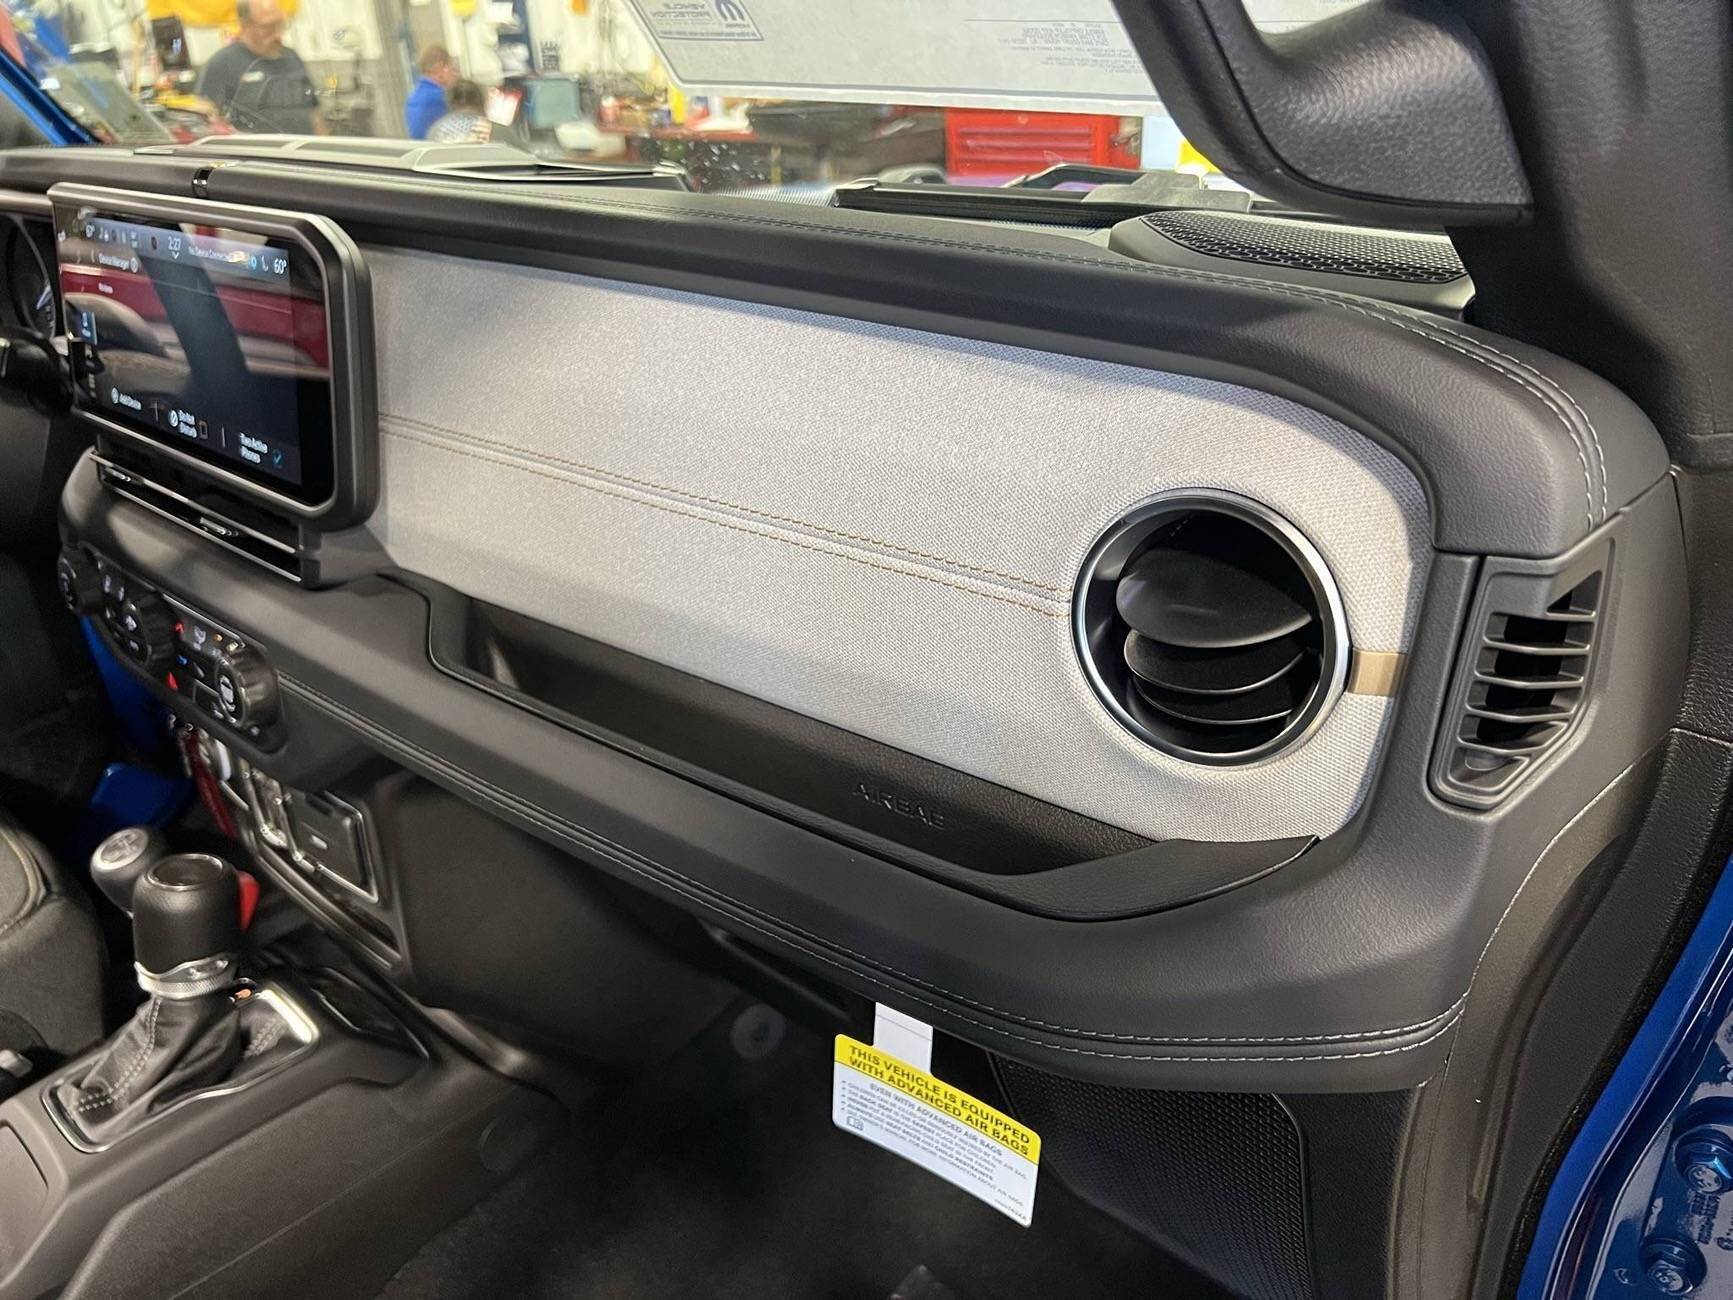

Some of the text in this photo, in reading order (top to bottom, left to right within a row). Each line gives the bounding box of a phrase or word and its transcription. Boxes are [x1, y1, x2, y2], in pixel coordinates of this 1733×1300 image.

[849, 1045, 880, 1065] THIS
[884, 1061, 941, 1095] VEHICLE
[944, 1090, 957, 1104] IS
[961, 1100, 1030, 1144] EQUIPPED
[849, 1056, 884, 1079] WITH
[888, 1075, 962, 1117] ADVANCED
[965, 1115, 988, 1133] AIR
[992, 1128, 1028, 1155] BAGS
[917, 1106, 962, 1133] ADVANCED
